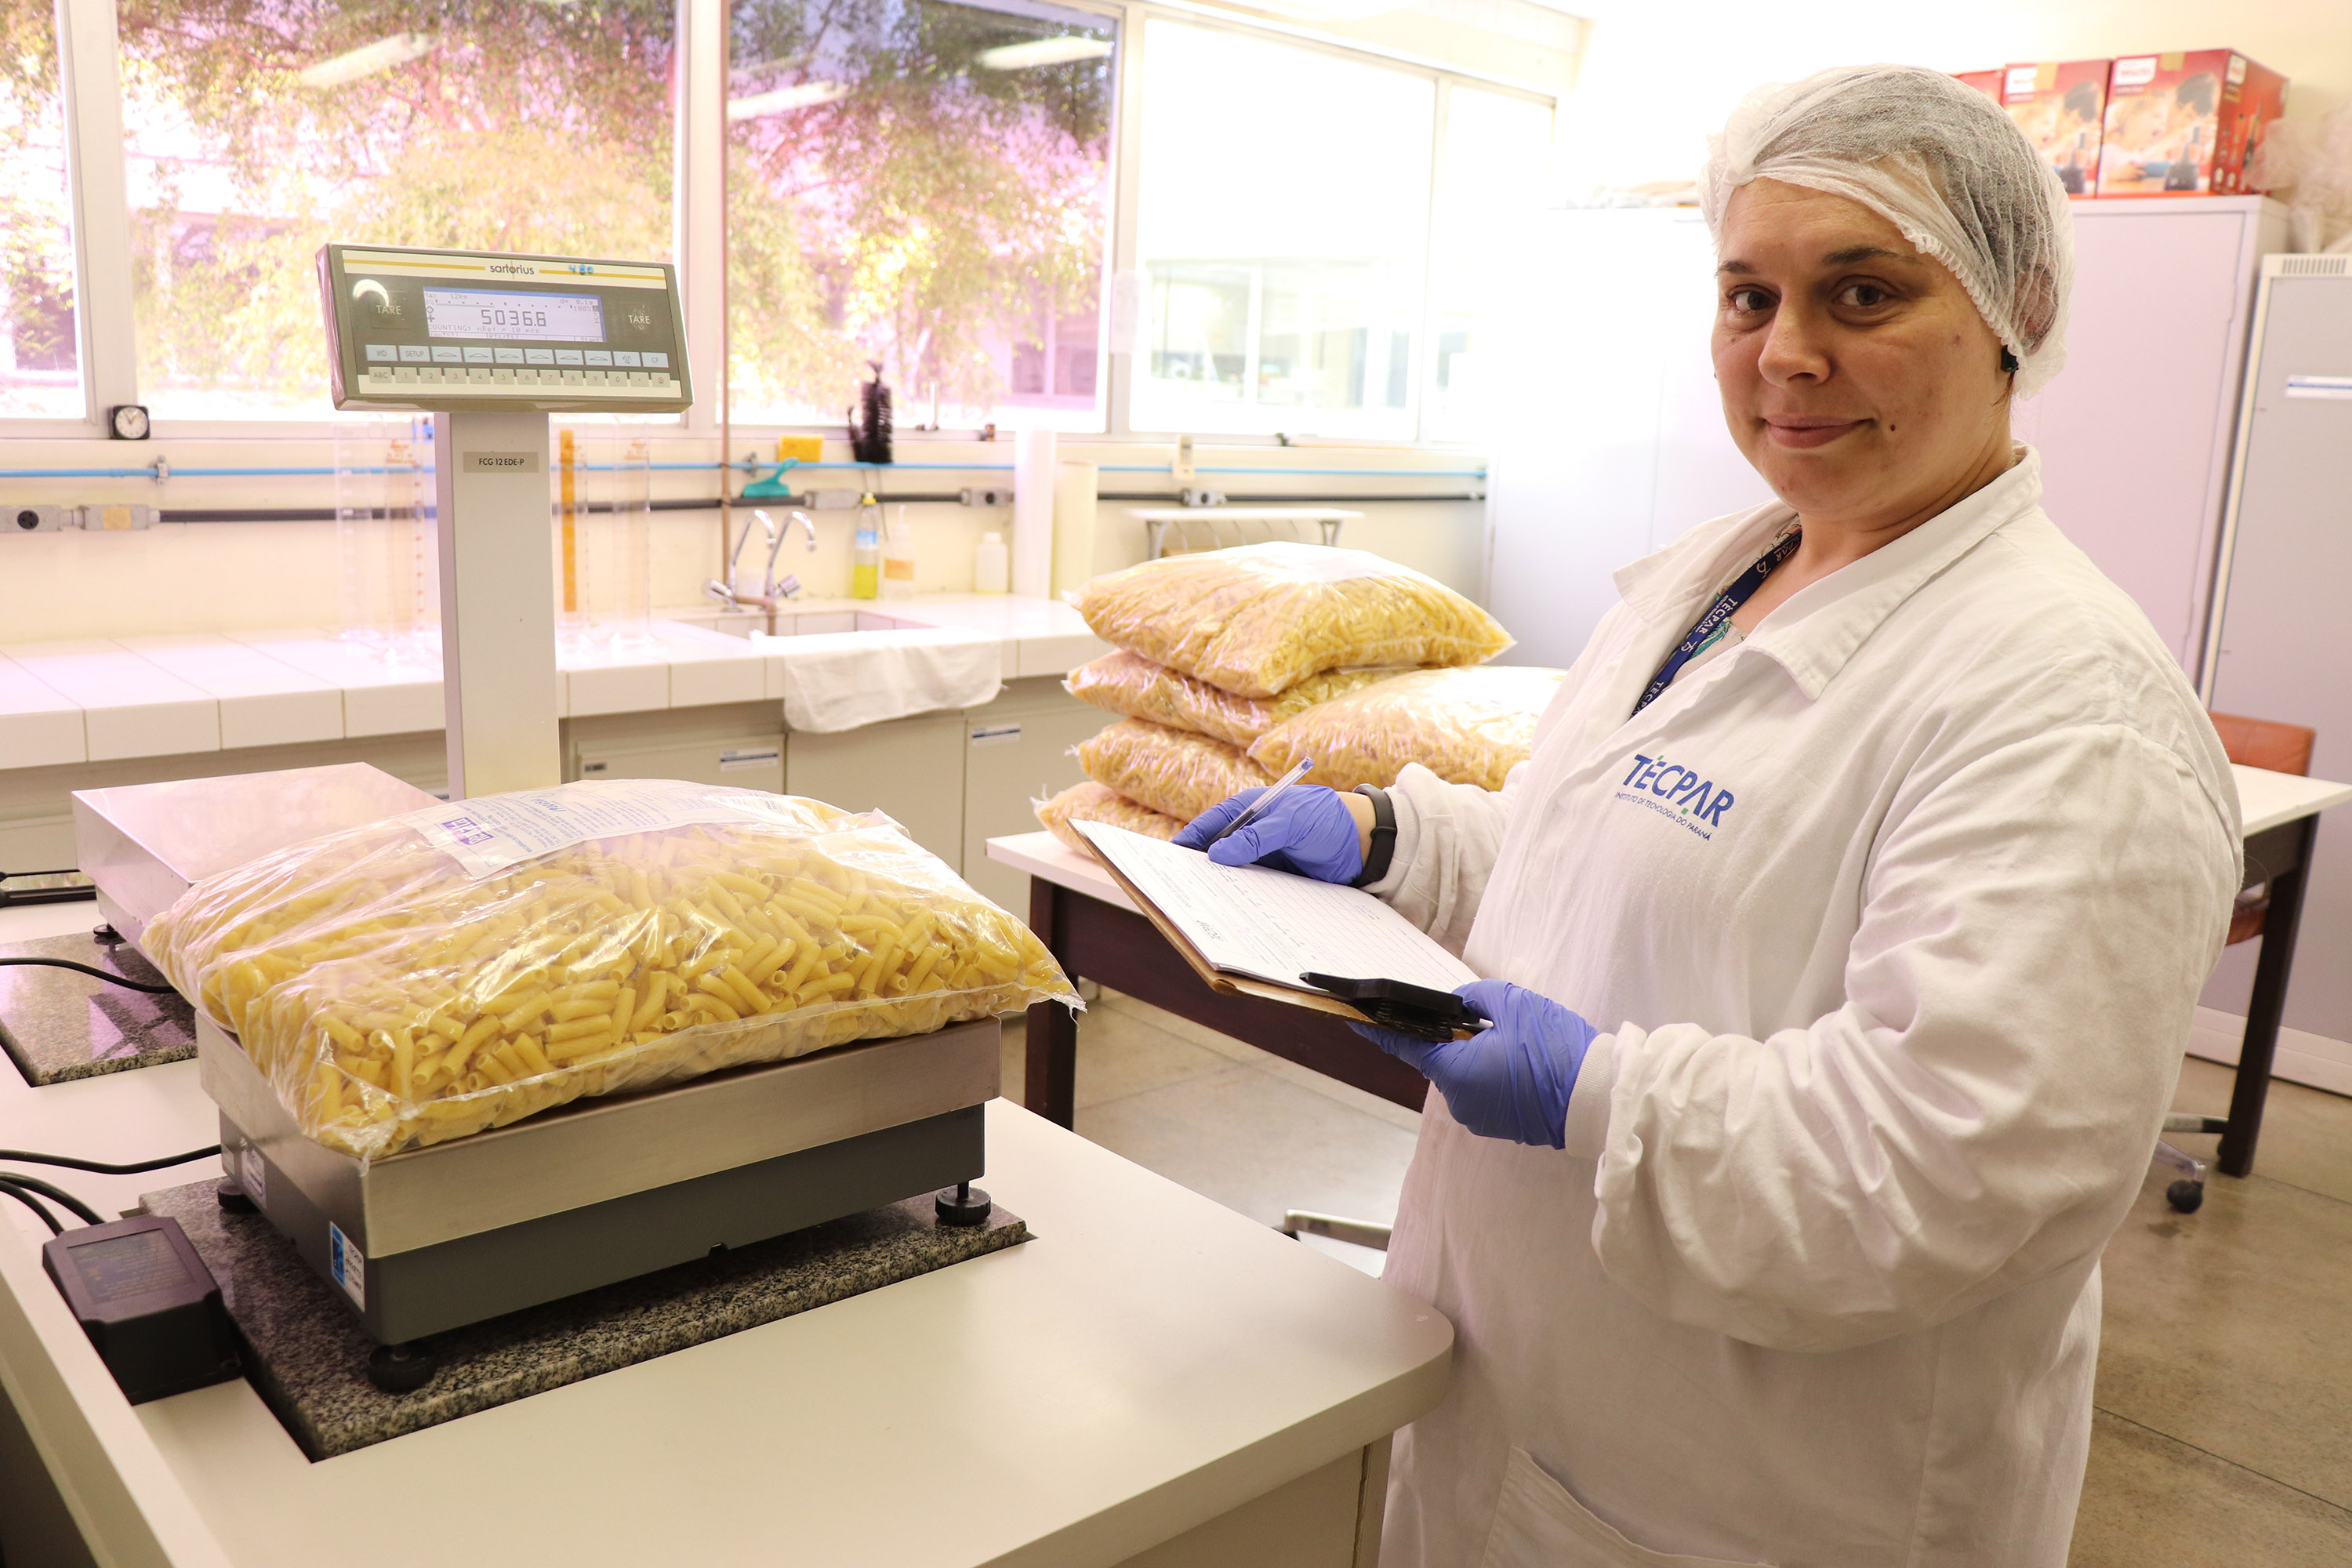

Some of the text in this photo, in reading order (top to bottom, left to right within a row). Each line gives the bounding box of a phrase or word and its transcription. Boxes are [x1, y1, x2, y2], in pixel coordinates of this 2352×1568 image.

[489, 263, 535, 275] sartorius
[376, 304, 402, 314] TARE
[628, 314, 651, 324] TARE
[1614, 792, 1638, 803] INSTITUTO
[1645, 800, 1676, 820] TECNOLOGIA
[1675, 816, 1687, 826] DO
[1686, 822, 1712, 841] PARANÁ
